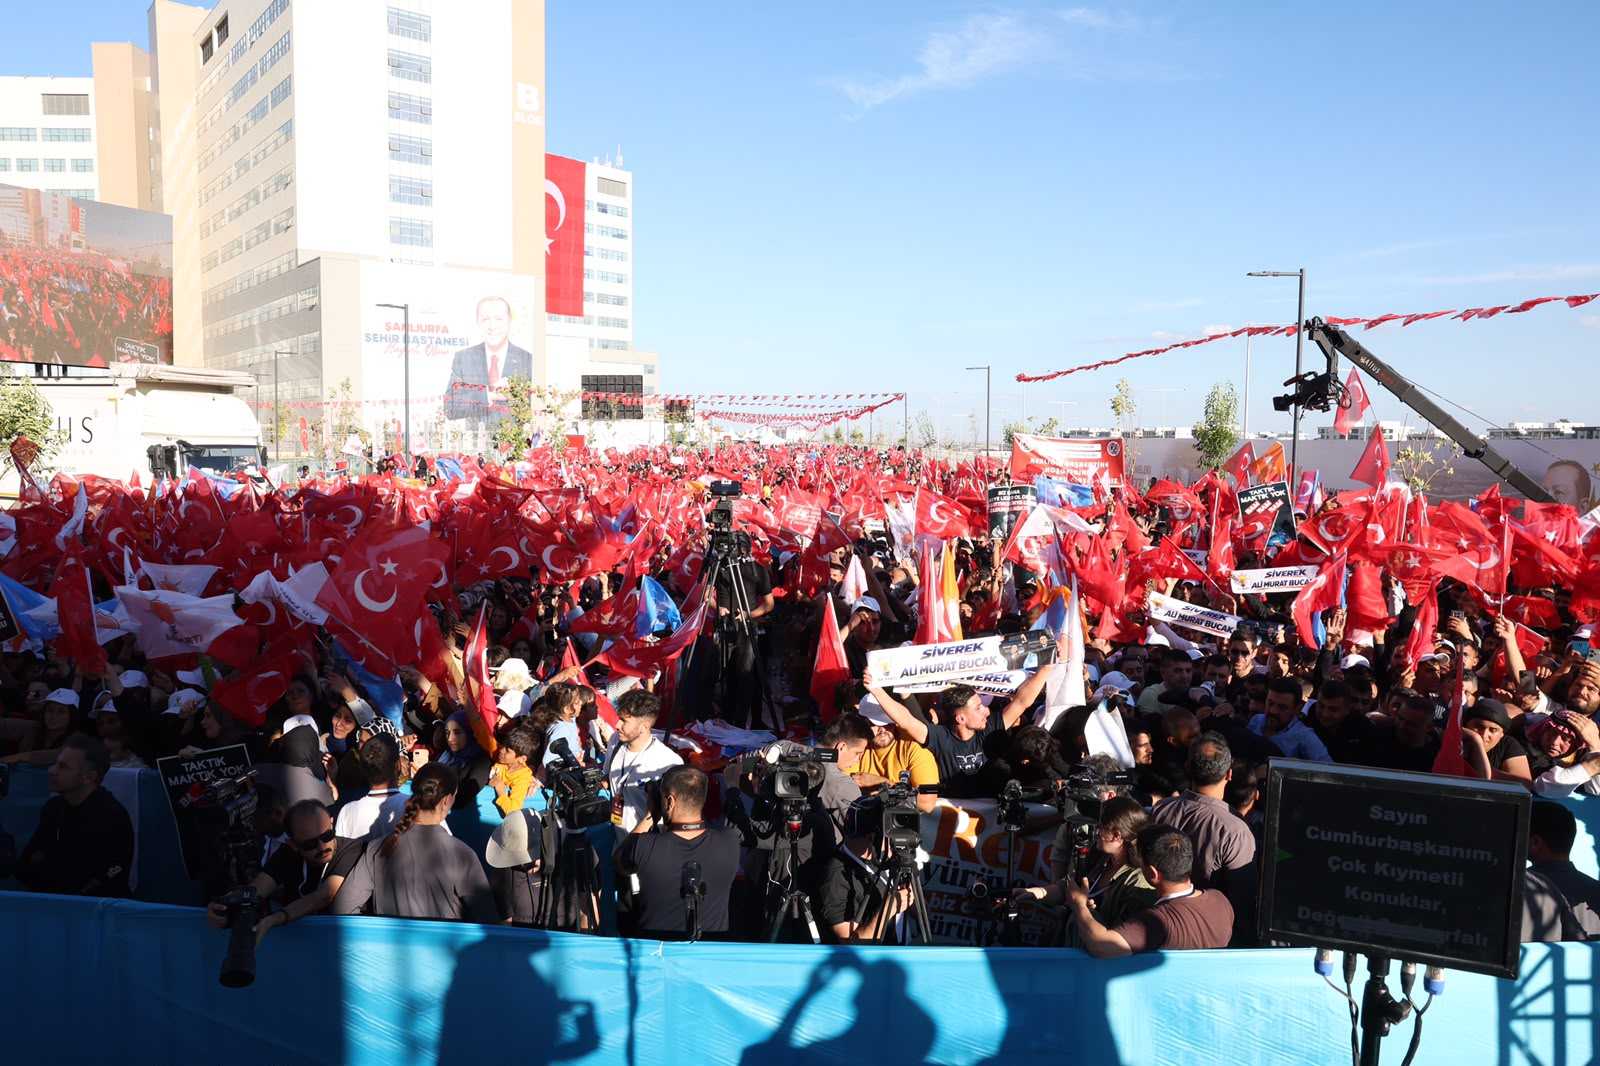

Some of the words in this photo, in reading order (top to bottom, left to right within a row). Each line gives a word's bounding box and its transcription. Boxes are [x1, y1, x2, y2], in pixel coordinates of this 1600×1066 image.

[517, 82, 539, 111] B
[1264, 579, 1288, 588] MURAT
[1289, 578, 1312, 586] BUCA
[1178, 612, 1204, 625] MURAT
[1204, 620, 1234, 633] BUCAK
[921, 642, 984, 660] SİVEREK
[900, 665, 917, 678] ALİ
[920, 661, 957, 675] MURAT
[959, 655, 998, 670] BUCAK
[219, 763, 245, 777] YOK
[1368, 805, 1428, 826] Sayın
[1327, 855, 1368, 873] Çok
[1374, 861, 1464, 887] Kıymetli
[1344, 885, 1447, 915] Konuklar,
